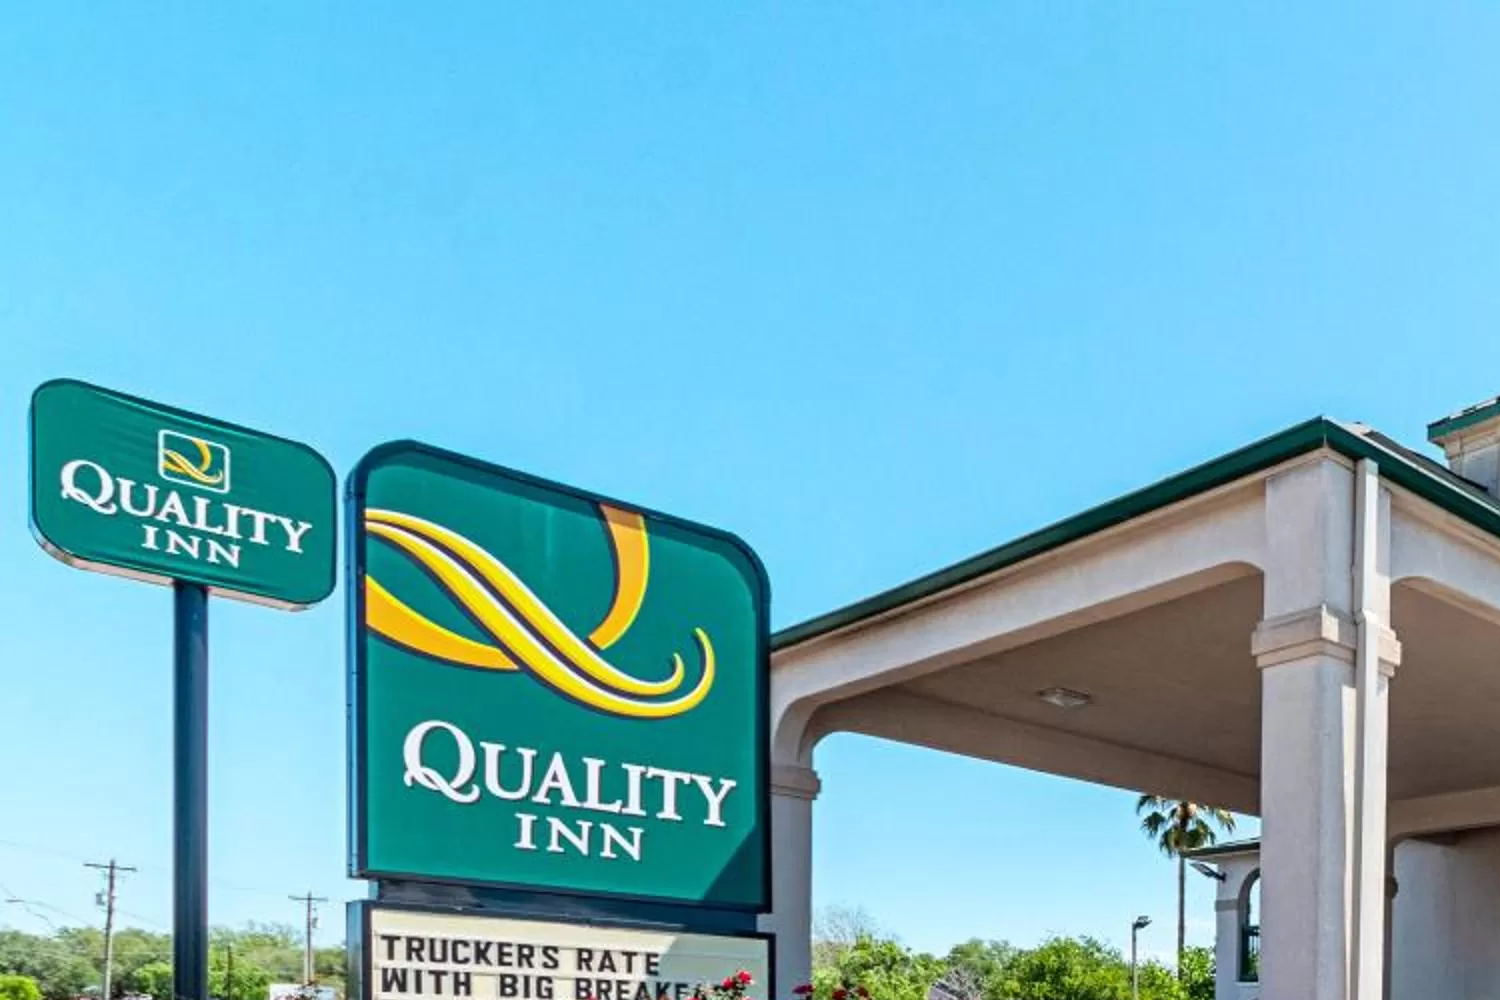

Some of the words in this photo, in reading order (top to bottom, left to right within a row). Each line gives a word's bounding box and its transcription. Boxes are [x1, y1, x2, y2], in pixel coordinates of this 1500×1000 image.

[60, 460, 312, 553] QUALITY
[141, 525, 241, 568] INN
[403, 720, 737, 826] QUALITY
[514, 813, 644, 861] INN
[380, 935, 559, 969] TRUCKERS
[576, 948, 659, 976] RATE
[381, 967, 472, 996] WITH
[500, 973, 553, 999] BIG
